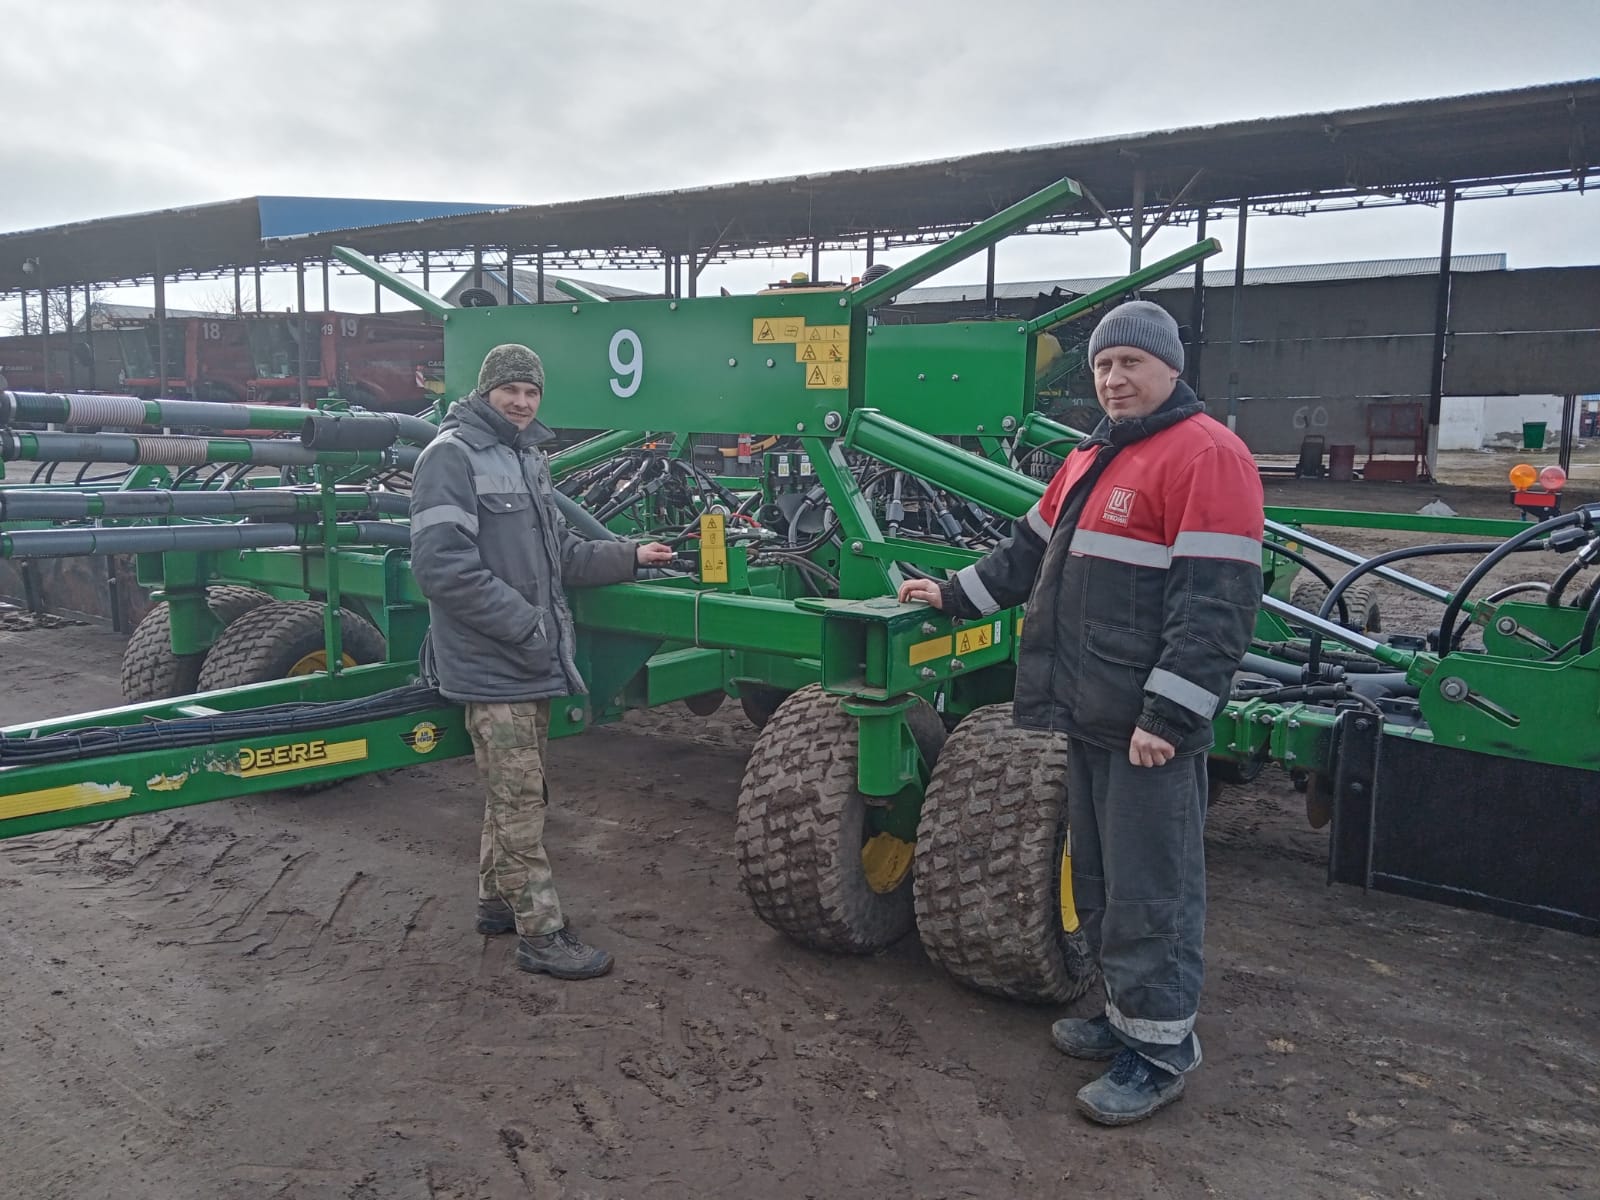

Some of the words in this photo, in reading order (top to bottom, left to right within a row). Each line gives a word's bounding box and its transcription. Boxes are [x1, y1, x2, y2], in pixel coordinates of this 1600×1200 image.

[203, 322, 221, 340] 18
[321, 324, 334, 336] 19
[341, 319, 358, 337] 19
[608, 328, 643, 398] 9
[238, 740, 326, 771] DEERE
